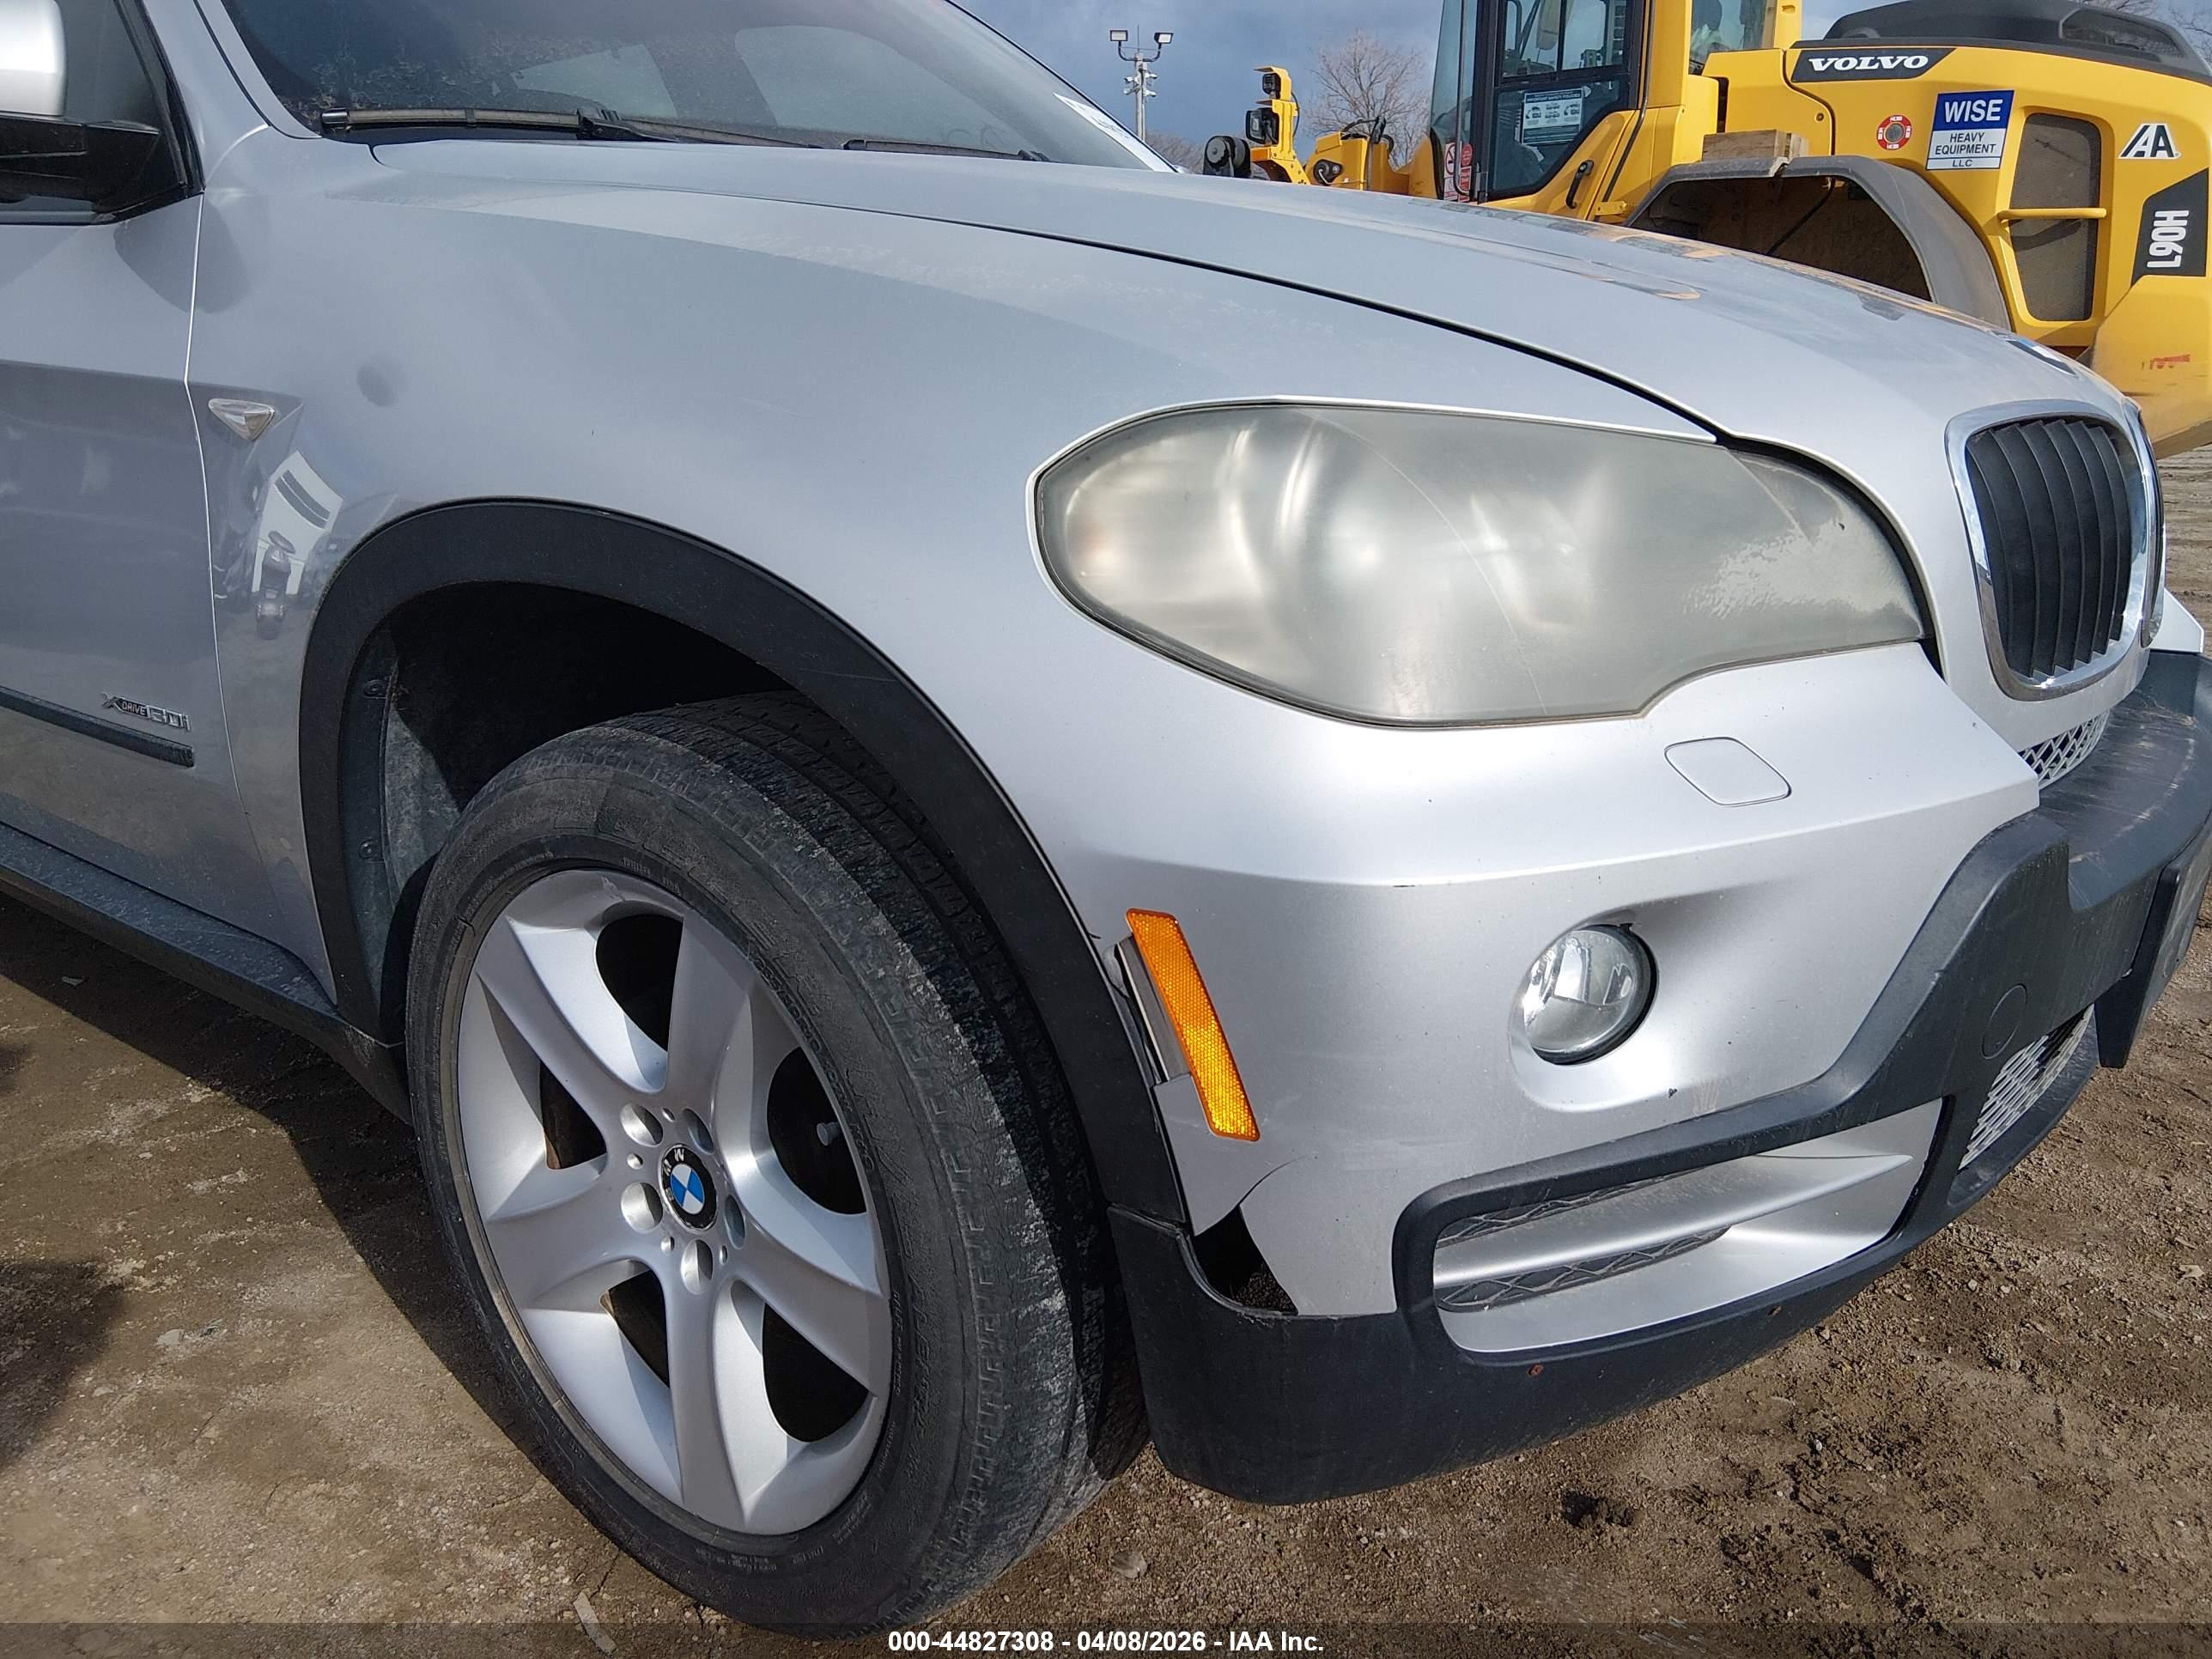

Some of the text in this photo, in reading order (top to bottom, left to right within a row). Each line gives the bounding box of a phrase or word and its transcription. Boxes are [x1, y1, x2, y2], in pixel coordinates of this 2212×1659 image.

[1808, 55, 1929, 71] VOLVO
[1944, 99, 2003, 123] WISE
[1949, 132, 1985, 143] HEAVY
[1935, 143, 1996, 155] EQUIPMENT
[1952, 159, 1973, 167] LLC
[2147, 210, 2190, 268] L90H
